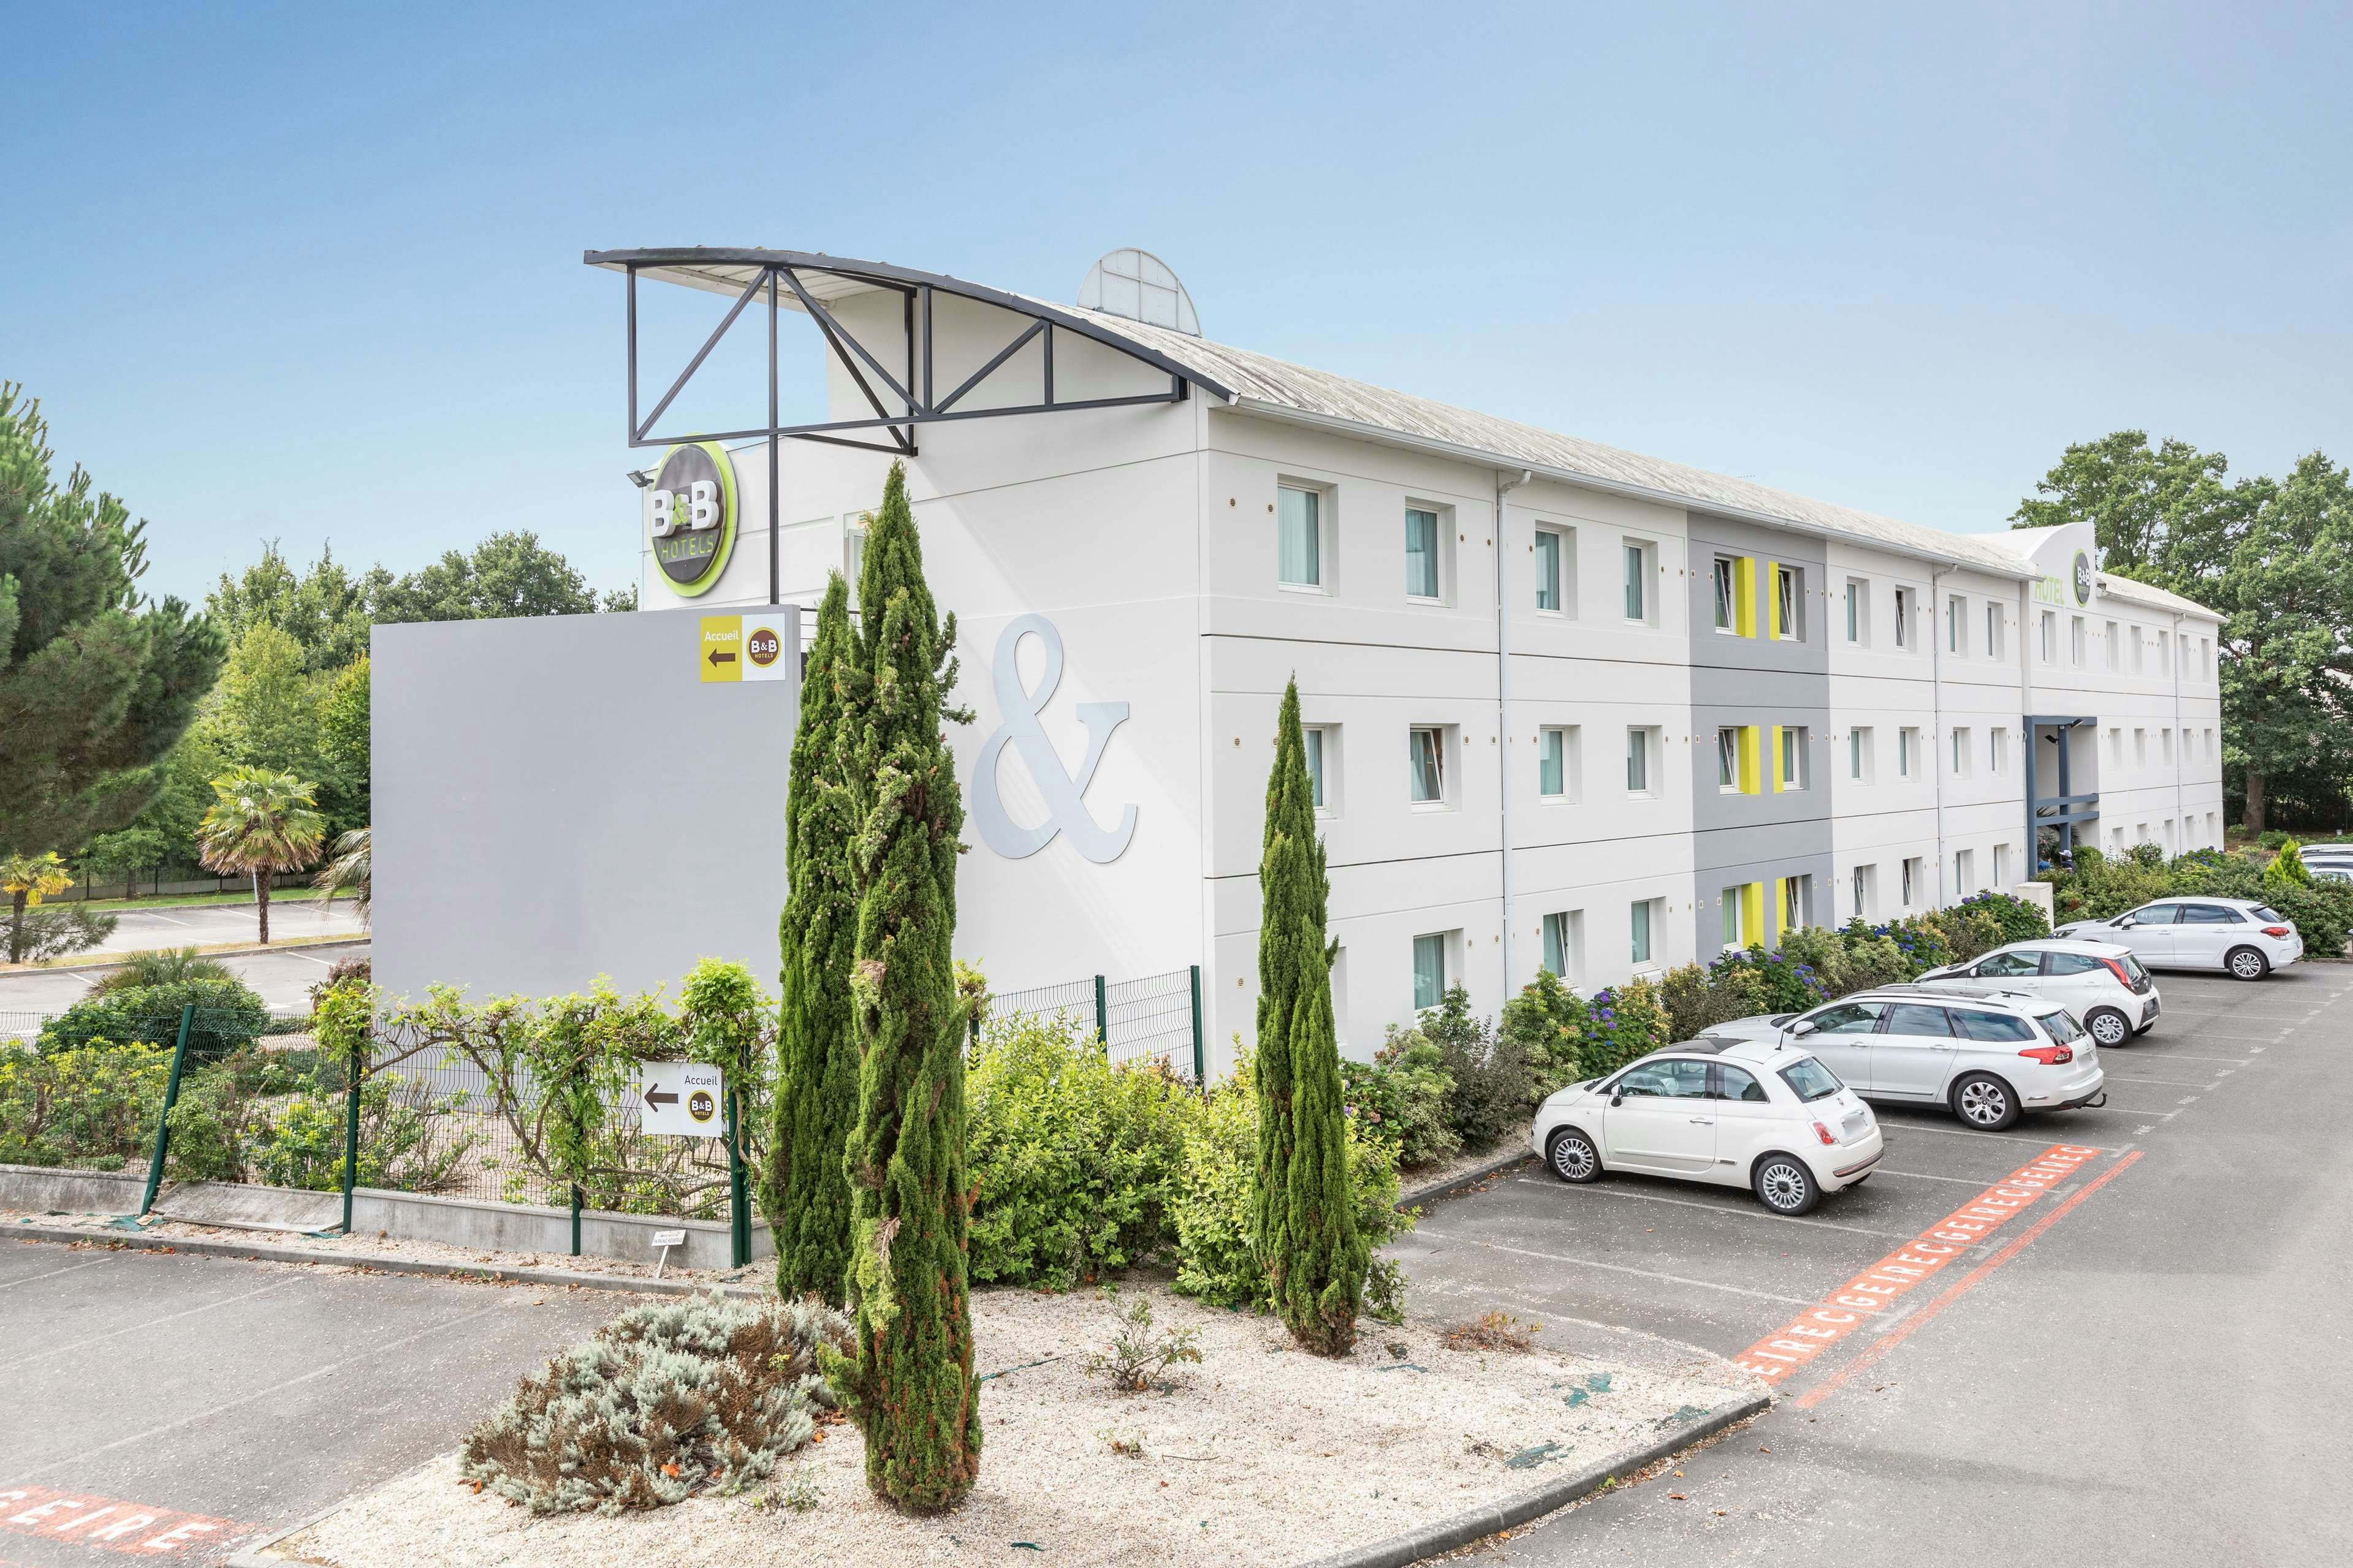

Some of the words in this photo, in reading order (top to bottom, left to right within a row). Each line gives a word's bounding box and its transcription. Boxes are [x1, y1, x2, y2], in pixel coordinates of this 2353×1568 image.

[651, 480, 719, 538] B&B
[661, 534, 715, 560] HOTELS
[704, 630, 739, 642] Accueil
[751, 640, 777, 653] B&B
[971, 613, 1138, 864] &
[685, 1075, 718, 1086] Accueil
[691, 1100, 712, 1112] B&B
[1737, 1311, 1855, 1376] EIREC
